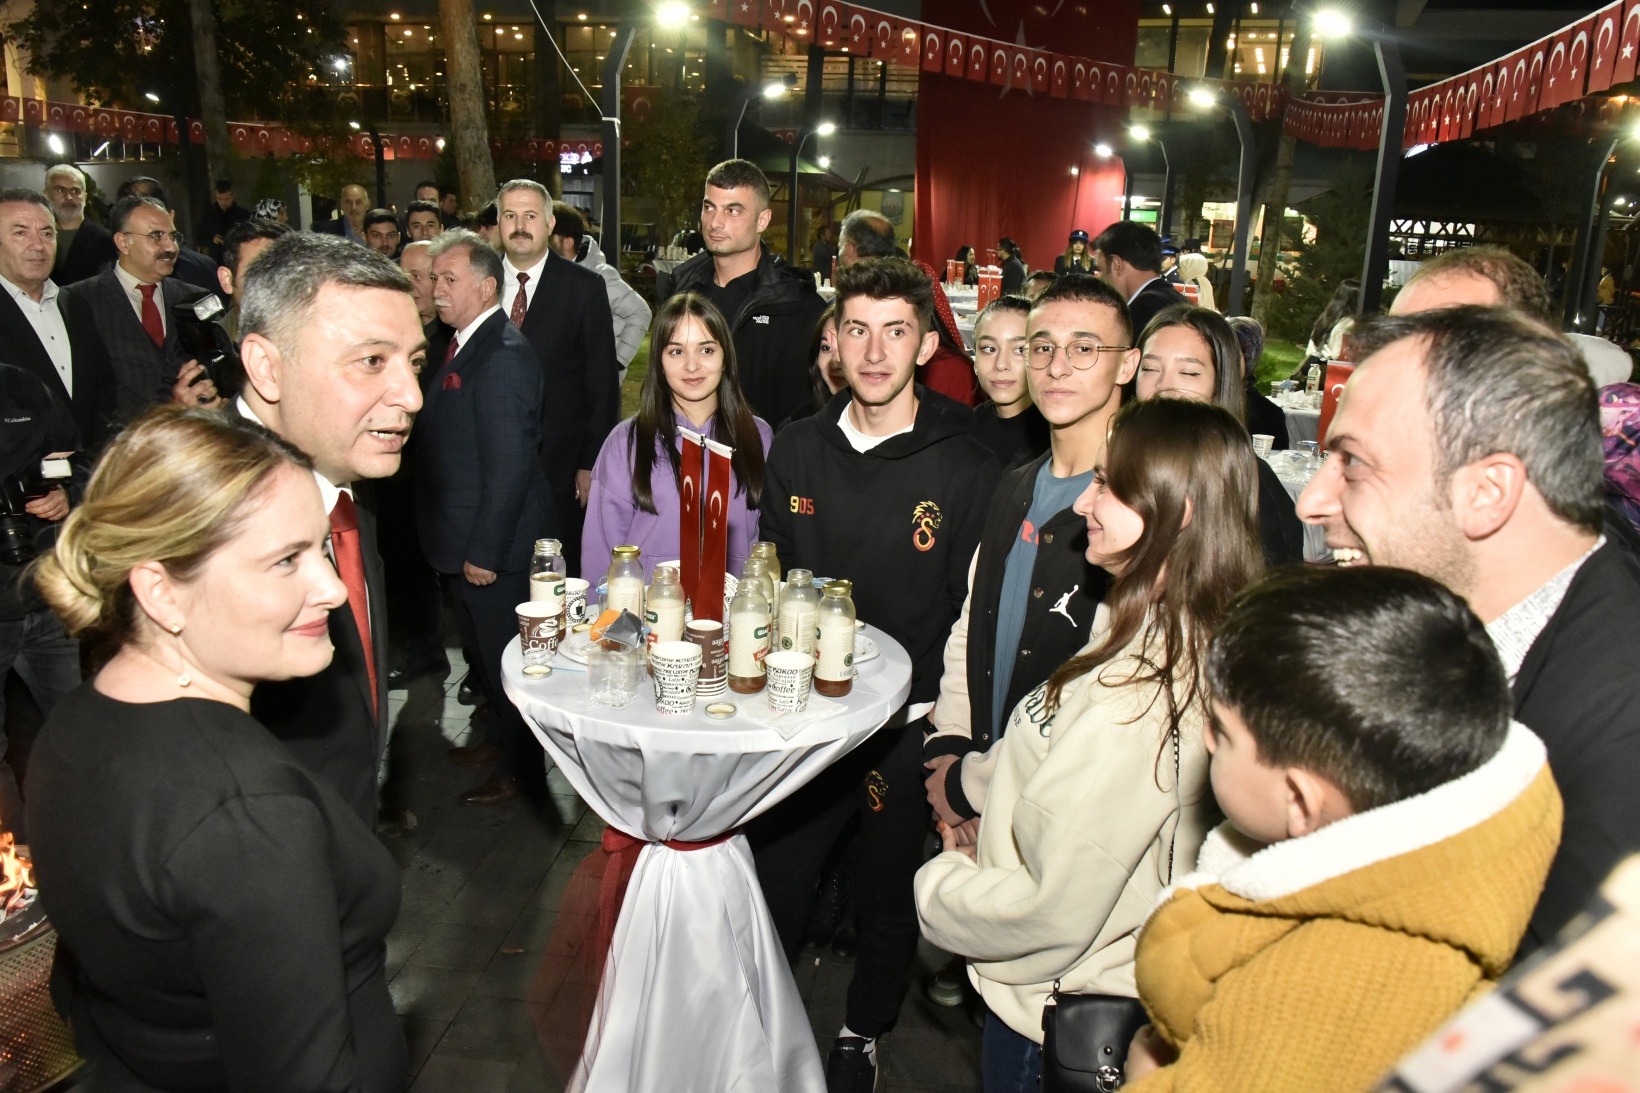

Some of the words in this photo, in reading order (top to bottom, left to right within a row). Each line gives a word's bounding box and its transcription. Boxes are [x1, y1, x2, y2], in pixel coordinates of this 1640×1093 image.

[790, 495, 815, 515] 905
[772, 667, 798, 675] Kakao
[771, 682, 796, 693] Coffee
